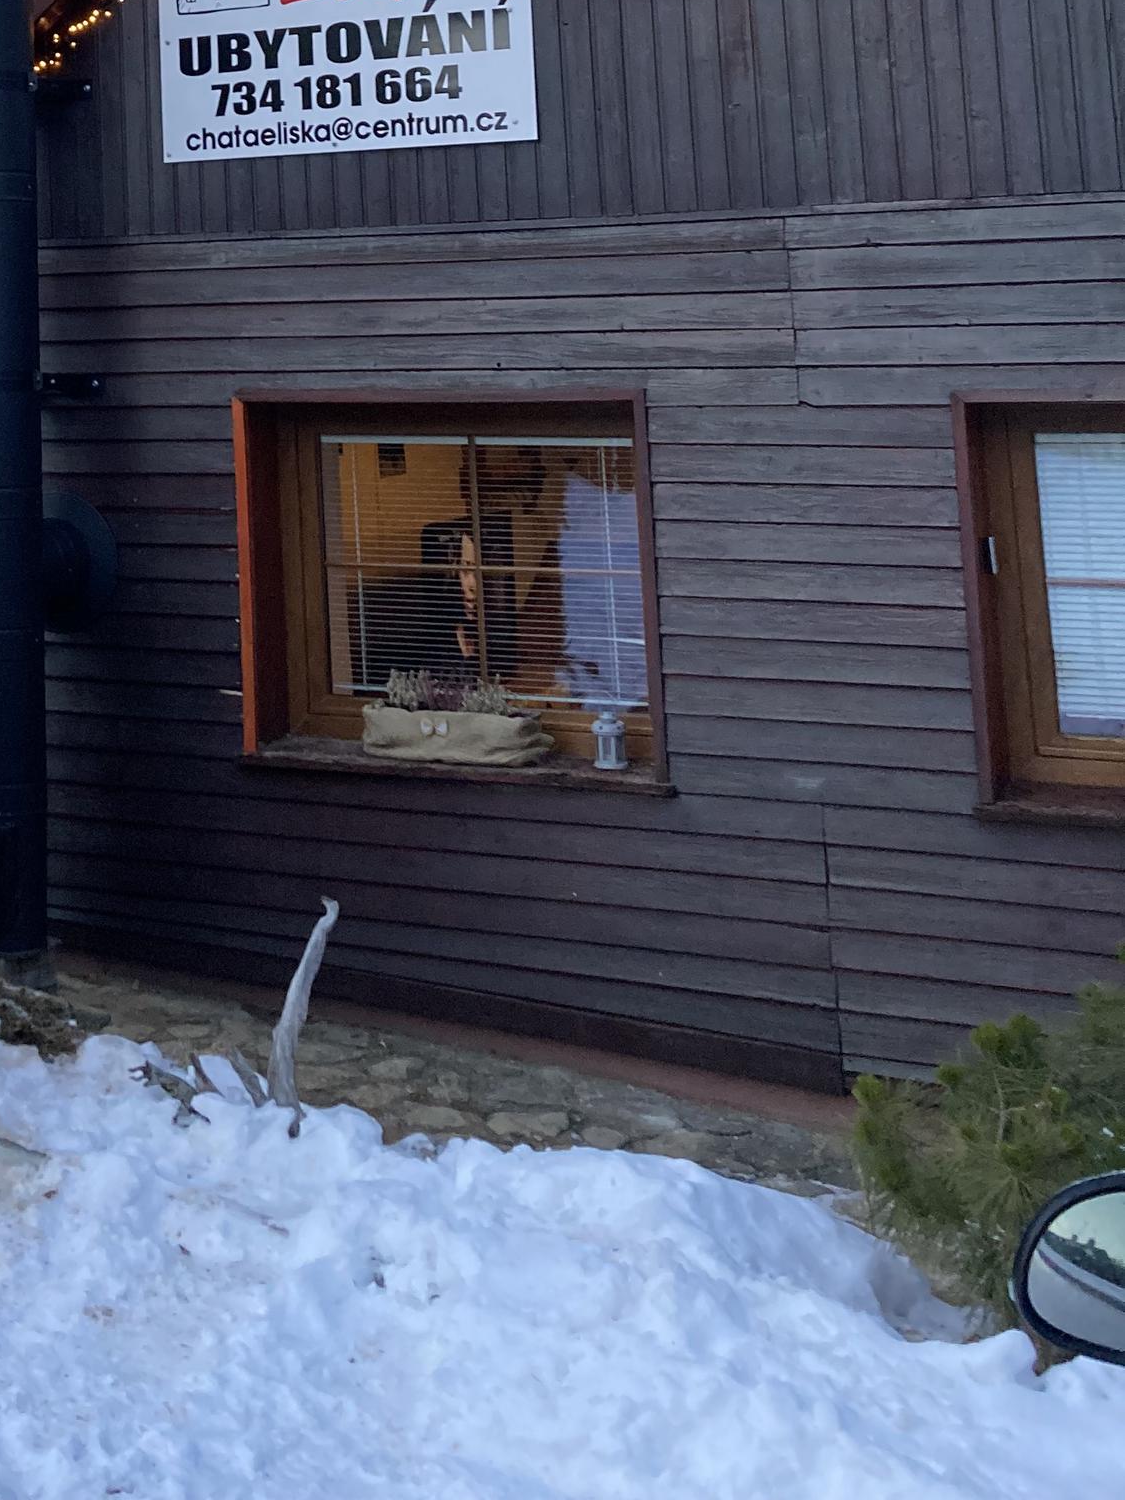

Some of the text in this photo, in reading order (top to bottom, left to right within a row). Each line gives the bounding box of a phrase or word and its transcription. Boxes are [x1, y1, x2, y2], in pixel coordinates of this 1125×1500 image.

[211, 64, 463, 117] 734 181 664
[186, 110, 509, 152] chataeliska@centrum.cz
